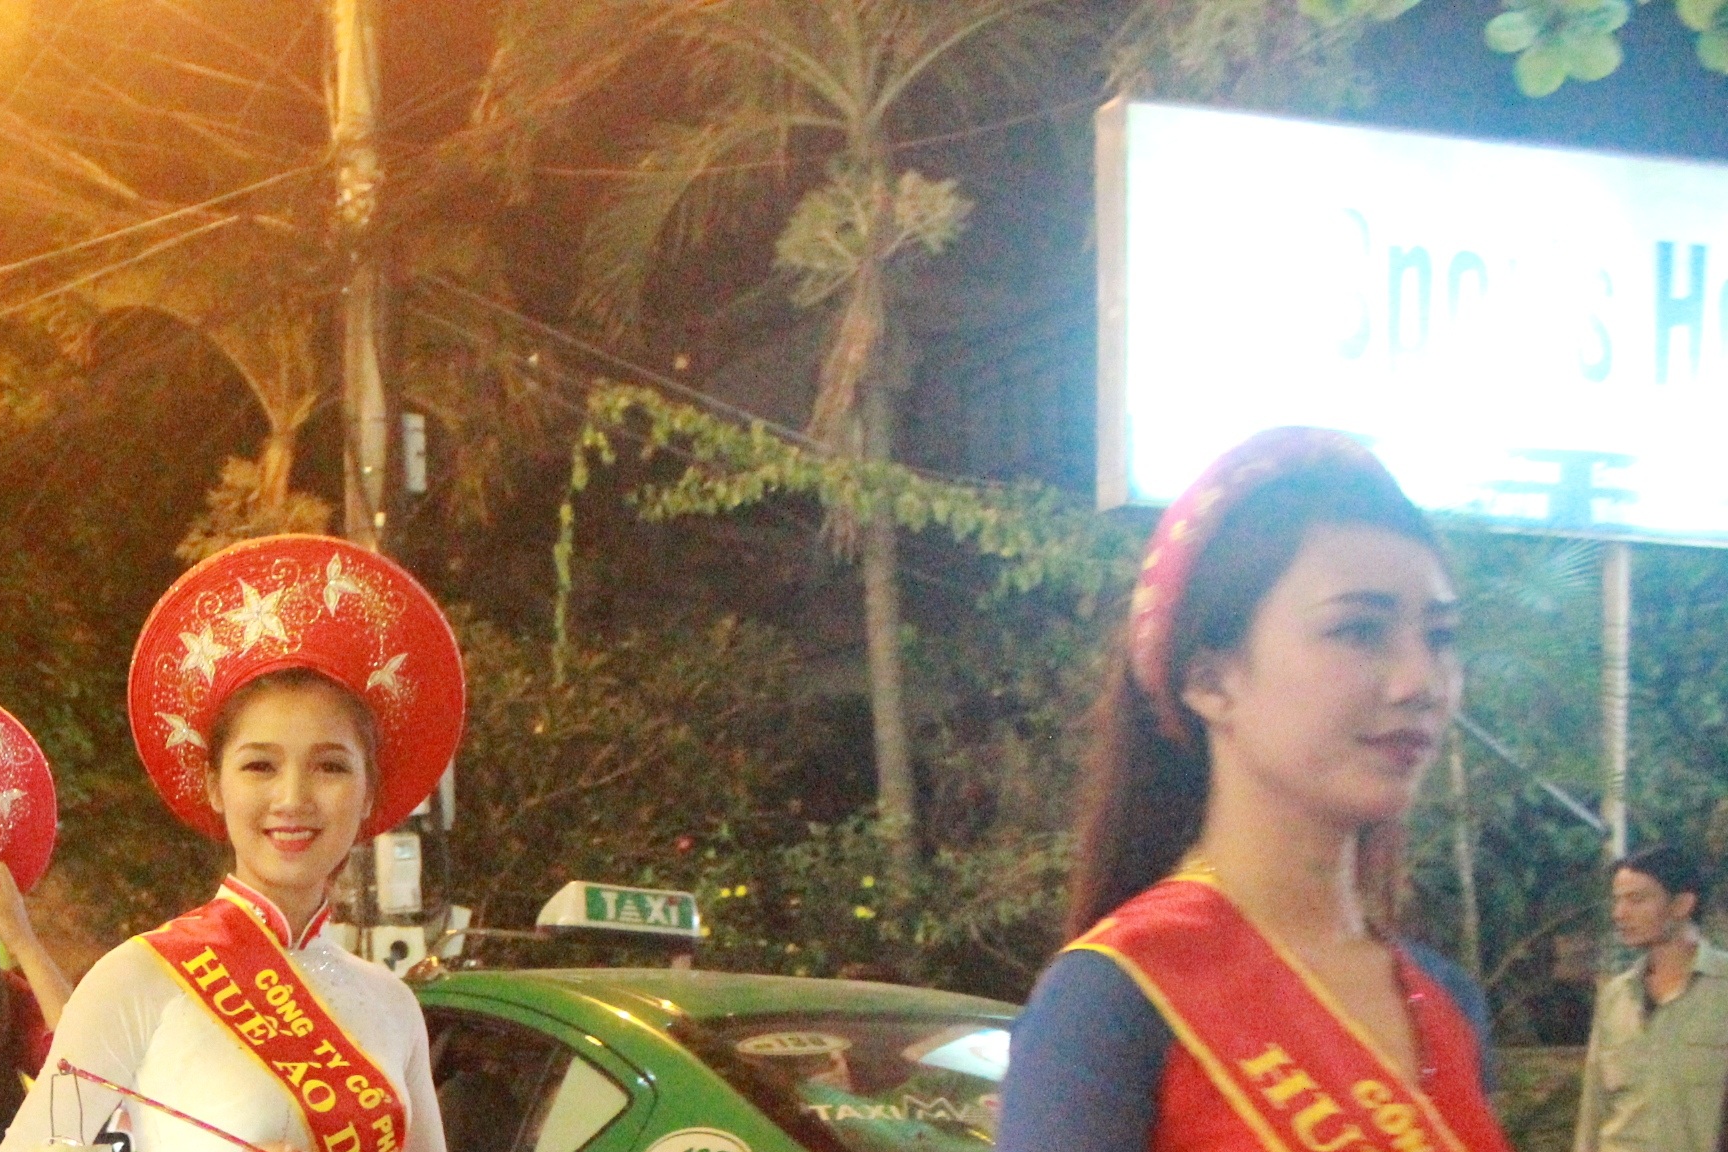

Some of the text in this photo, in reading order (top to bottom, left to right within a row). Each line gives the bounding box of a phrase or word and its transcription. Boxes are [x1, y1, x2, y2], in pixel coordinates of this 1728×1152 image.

[181, 945, 294, 1046] HUẾ
[272, 1060, 336, 1113] ÁO
[254, 968, 314, 1038] CÔNG
[314, 1039, 352, 1069] TY
